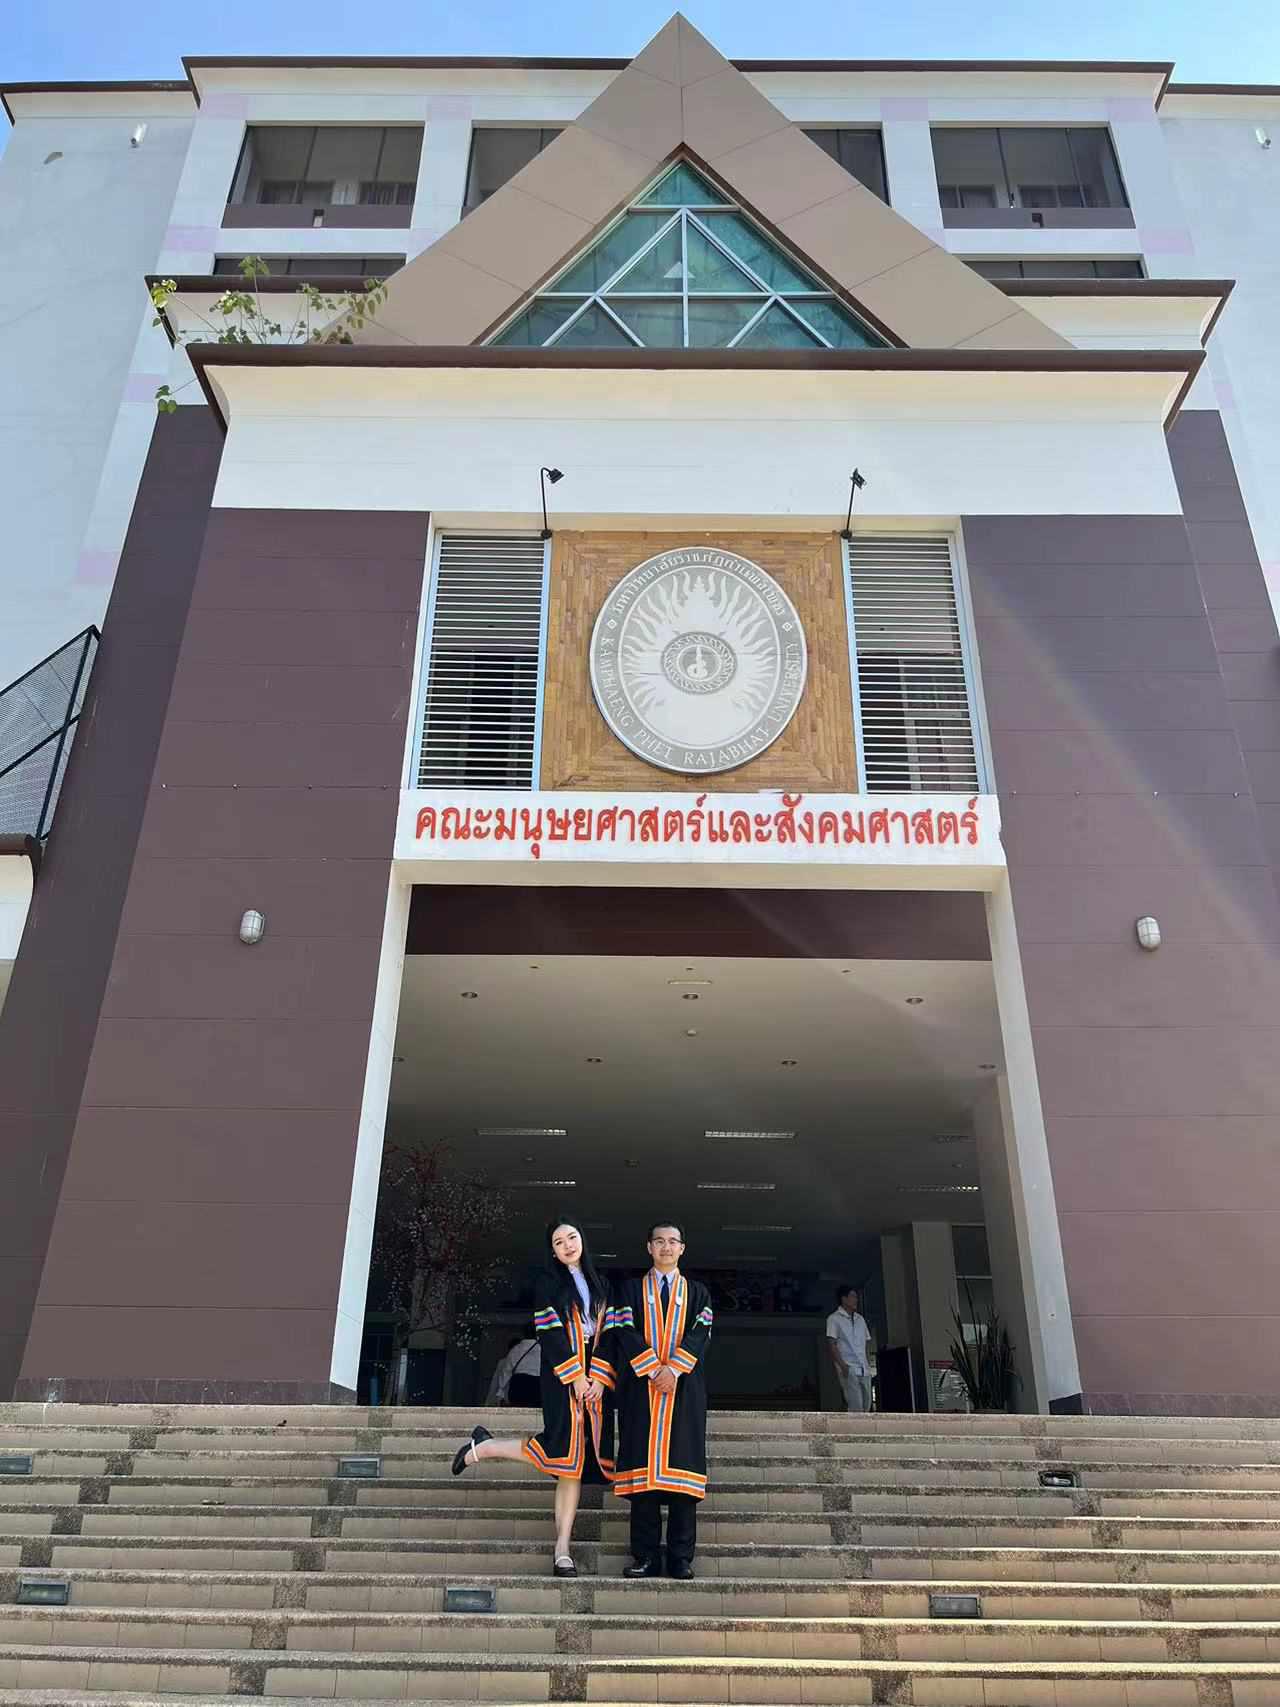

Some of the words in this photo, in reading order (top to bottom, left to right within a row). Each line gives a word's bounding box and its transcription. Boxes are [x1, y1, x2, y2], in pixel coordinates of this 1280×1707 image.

[600, 636, 635, 728] KAMPHAENG
[633, 728, 672, 760] PHET
[683, 727, 772, 768] RAJABHAT
[767, 640, 799, 723] UNIVERSITY
[415, 793, 979, 859] คณะมนุษยศาสตร์และสังคมศาสตร์
